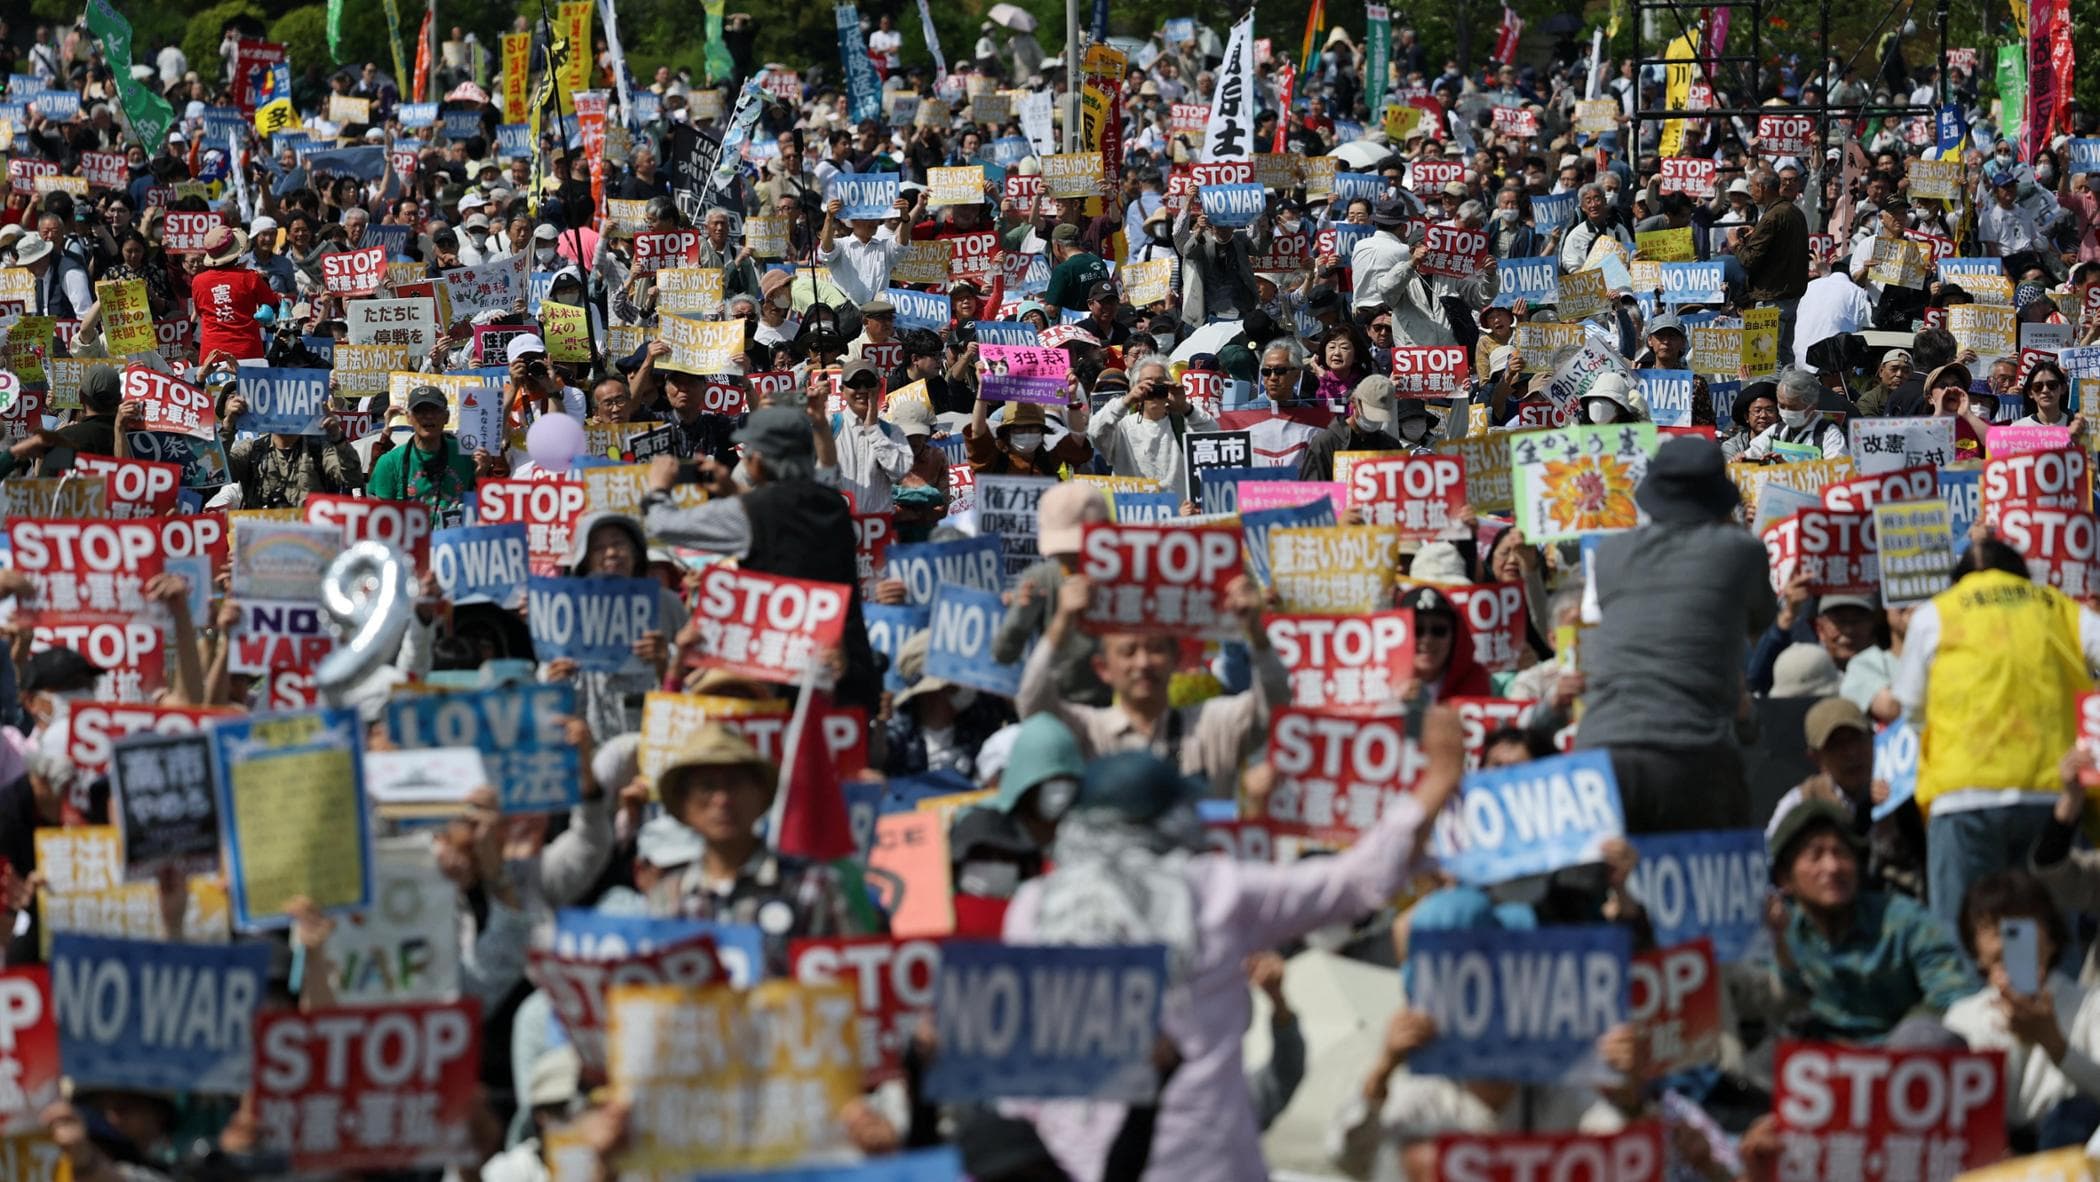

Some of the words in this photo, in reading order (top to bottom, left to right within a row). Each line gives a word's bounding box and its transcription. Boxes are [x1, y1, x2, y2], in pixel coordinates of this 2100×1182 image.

[38, 97, 51, 111] NO
[54, 97, 77, 112] WAR
[1172, 104, 1209, 119] STOP
[1494, 108, 1532, 122] STOP
[1760, 118, 1811, 137] STOP
[500, 135, 514, 146] NO
[2071, 144, 2087, 160] NO
[11, 161, 57, 176] STOP
[82, 154, 126, 170] STOP
[1413, 163, 1463, 180] STOP
[1662, 160, 1713, 177] STOP
[1193, 165, 1252, 185] STOP
[837, 182, 858, 206] NO
[861, 181, 896, 206] WAR
[1203, 189, 1226, 212] NO
[1229, 189, 1261, 213] WAR
[1335, 179, 1358, 200] NO
[1361, 179, 1386, 200] WAR
[167, 215, 222, 232] STOP
[1533, 203, 1548, 223] NO
[636, 236, 696, 255] STOP
[1336, 227, 1359, 250] NO
[1427, 227, 1486, 255] STOP
[323, 250, 383, 275] STOP
[950, 257, 992, 274] 憲・軍拡
[448, 271, 475, 284] 戦争
[477, 282, 507, 295] 増税
[658, 271, 720, 292] 憲法いかして
[1518, 264, 1554, 290] WAR
[1662, 269, 1683, 291] NO
[1687, 269, 1721, 291] WAR
[107, 299, 140, 312] 市民と
[211, 283, 236, 323] 憲法
[364, 306, 421, 322] ただちに
[549, 308, 582, 319] 未来は
[889, 293, 916, 316] NO
[919, 297, 948, 322] WAR
[108, 311, 144, 327] 野党の
[551, 322, 576, 335] 女の
[1951, 307, 2015, 330] 憲法いかして
[111, 323, 149, 339] 共闘で
[660, 318, 742, 346] 憲法いかして
[1695, 332, 1743, 350] 憲法いか
[336, 349, 405, 370] 憲法いかして
[671, 345, 731, 368] 和な世界を
[1014, 350, 1065, 365] 独裁
[1395, 348, 1464, 373] STOP
[1695, 352, 1741, 368] 平和な世界
[127, 373, 210, 410] STOP
[336, 373, 390, 391] 平和な世界
[1398, 373, 1457, 394] 改憲・軍拡
[1655, 380, 1692, 405] WAR
[240, 378, 272, 415] NO
[275, 377, 324, 415] WAR
[340, 415, 370, 438] STO
[1521, 406, 1565, 427] STO
[1194, 438, 1245, 465] 高市
[1862, 435, 1905, 454] 改憲
[1905, 448, 1945, 468] 反対
[1354, 460, 1459, 500] STOP
[1986, 453, 2084, 501] STOP
[480, 483, 585, 522] STOP
[1204, 485, 1236, 513] NO
[13, 521, 155, 571] STOP
[161, 520, 220, 557] OP
[2002, 509, 2097, 561] STO
[459, 539, 527, 588] WAR
[1084, 529, 1237, 583] STOP
[889, 555, 932, 606] NO
[937, 549, 998, 594] WAR
[1802, 554, 1878, 584] 改憲・軍
[705, 571, 840, 633] STOP
[251, 607, 320, 633] NO
[530, 593, 574, 645] NO
[579, 594, 652, 645] WAR
[934, 600, 985, 658] NO
[1267, 617, 1406, 666] STOP
[1439, 786, 1503, 852] NO
[1504, 768, 1610, 841] WAR
[1634, 856, 1683, 929] NO
[1690, 854, 1765, 925] WAR
[1412, 949, 1493, 1037] NO
[1502, 950, 1621, 1038] WAR
[1631, 951, 1708, 1019] OP
[53, 958, 129, 1043] NO
[139, 964, 258, 1048] WAR
[939, 966, 1023, 1057] NO
[1029, 968, 1157, 1054] WAR
[262, 1012, 469, 1091] STOP
[1780, 1050, 1996, 1131] STOP
